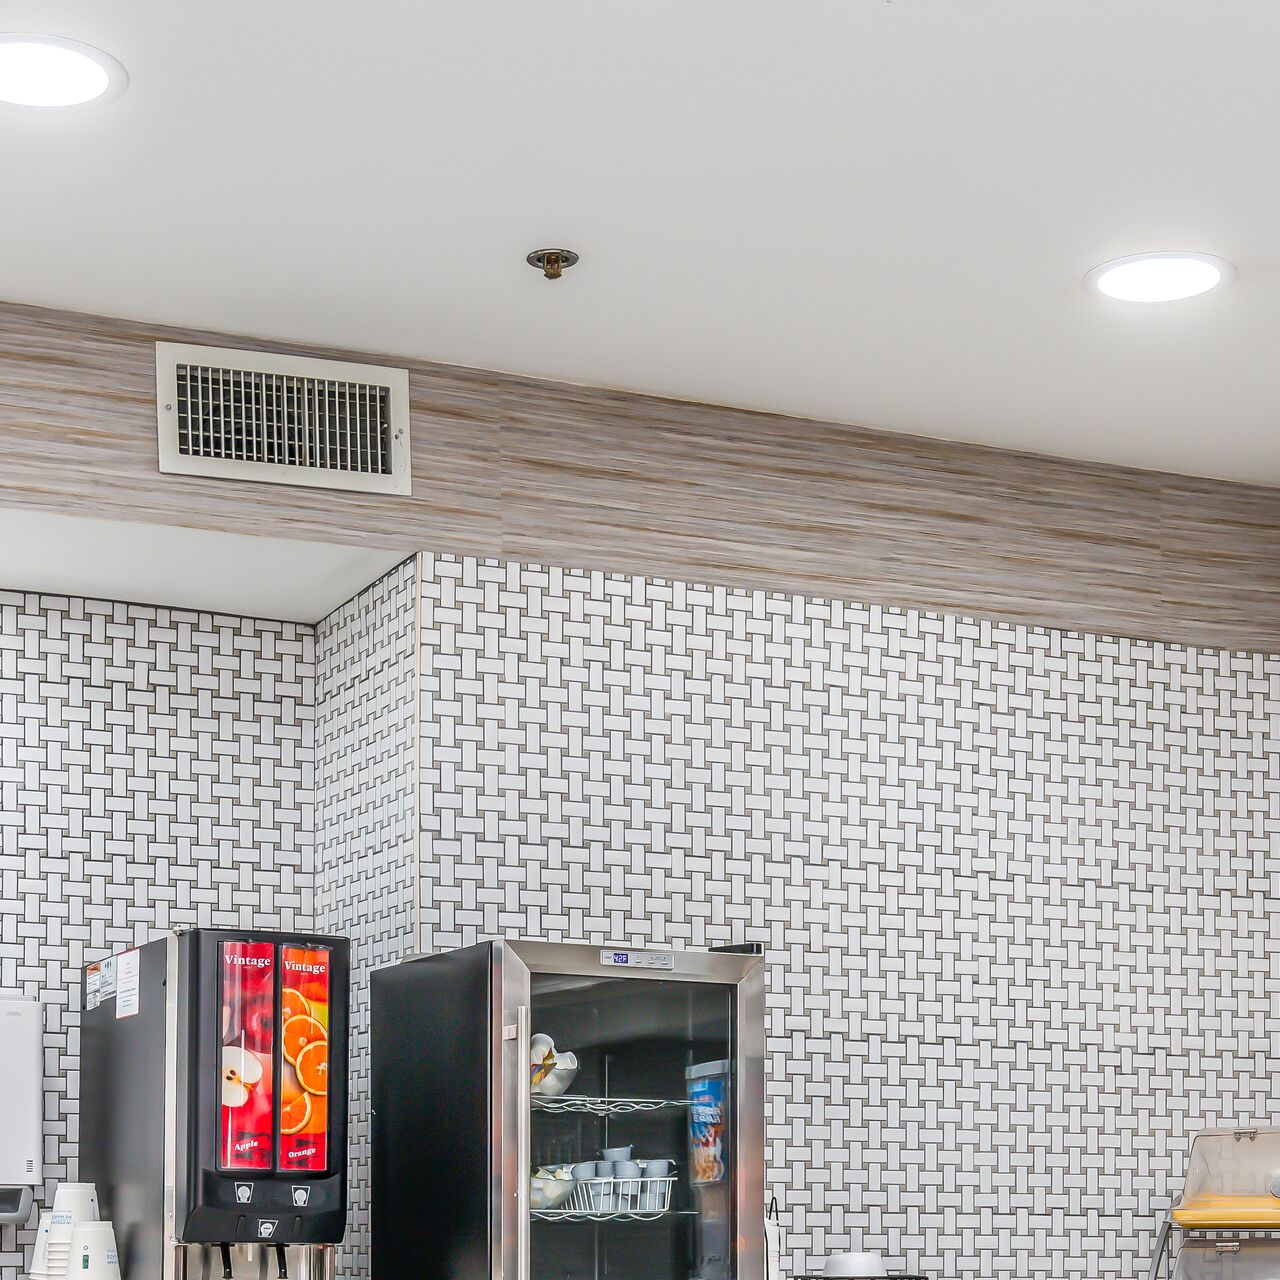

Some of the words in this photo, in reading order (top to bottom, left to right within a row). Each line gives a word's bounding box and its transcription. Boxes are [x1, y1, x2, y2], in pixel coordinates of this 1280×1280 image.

[224, 954, 271, 968] Vintage
[284, 960, 326, 975] Vintage
[234, 1139, 259, 1152] Apple
[287, 1147, 317, 1159] Orange
